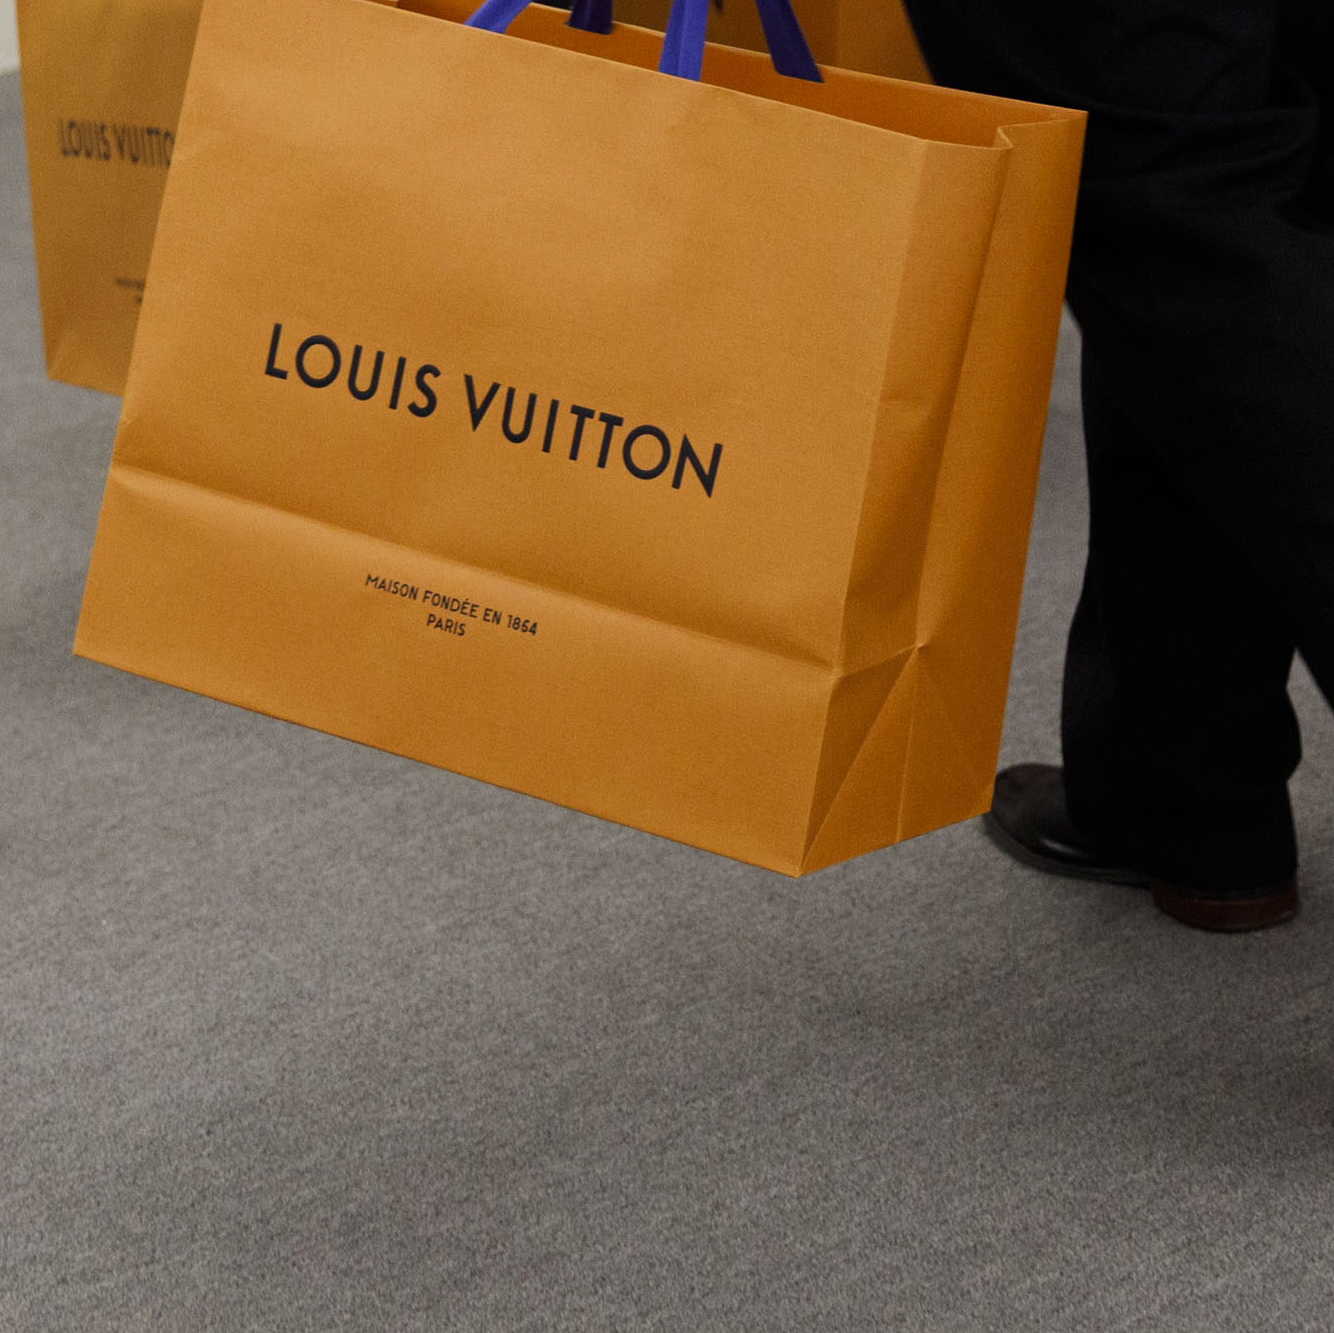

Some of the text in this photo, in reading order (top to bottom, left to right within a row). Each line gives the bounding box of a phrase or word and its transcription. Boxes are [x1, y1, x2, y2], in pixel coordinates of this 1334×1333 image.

[58, 119, 173, 169] LOUIS VUITTO
[264, 323, 723, 498] LOUIS VUITTON
[365, 574, 539, 636] MAISON FONDÉE EN 1854
[427, 614, 466, 637] PARIS
